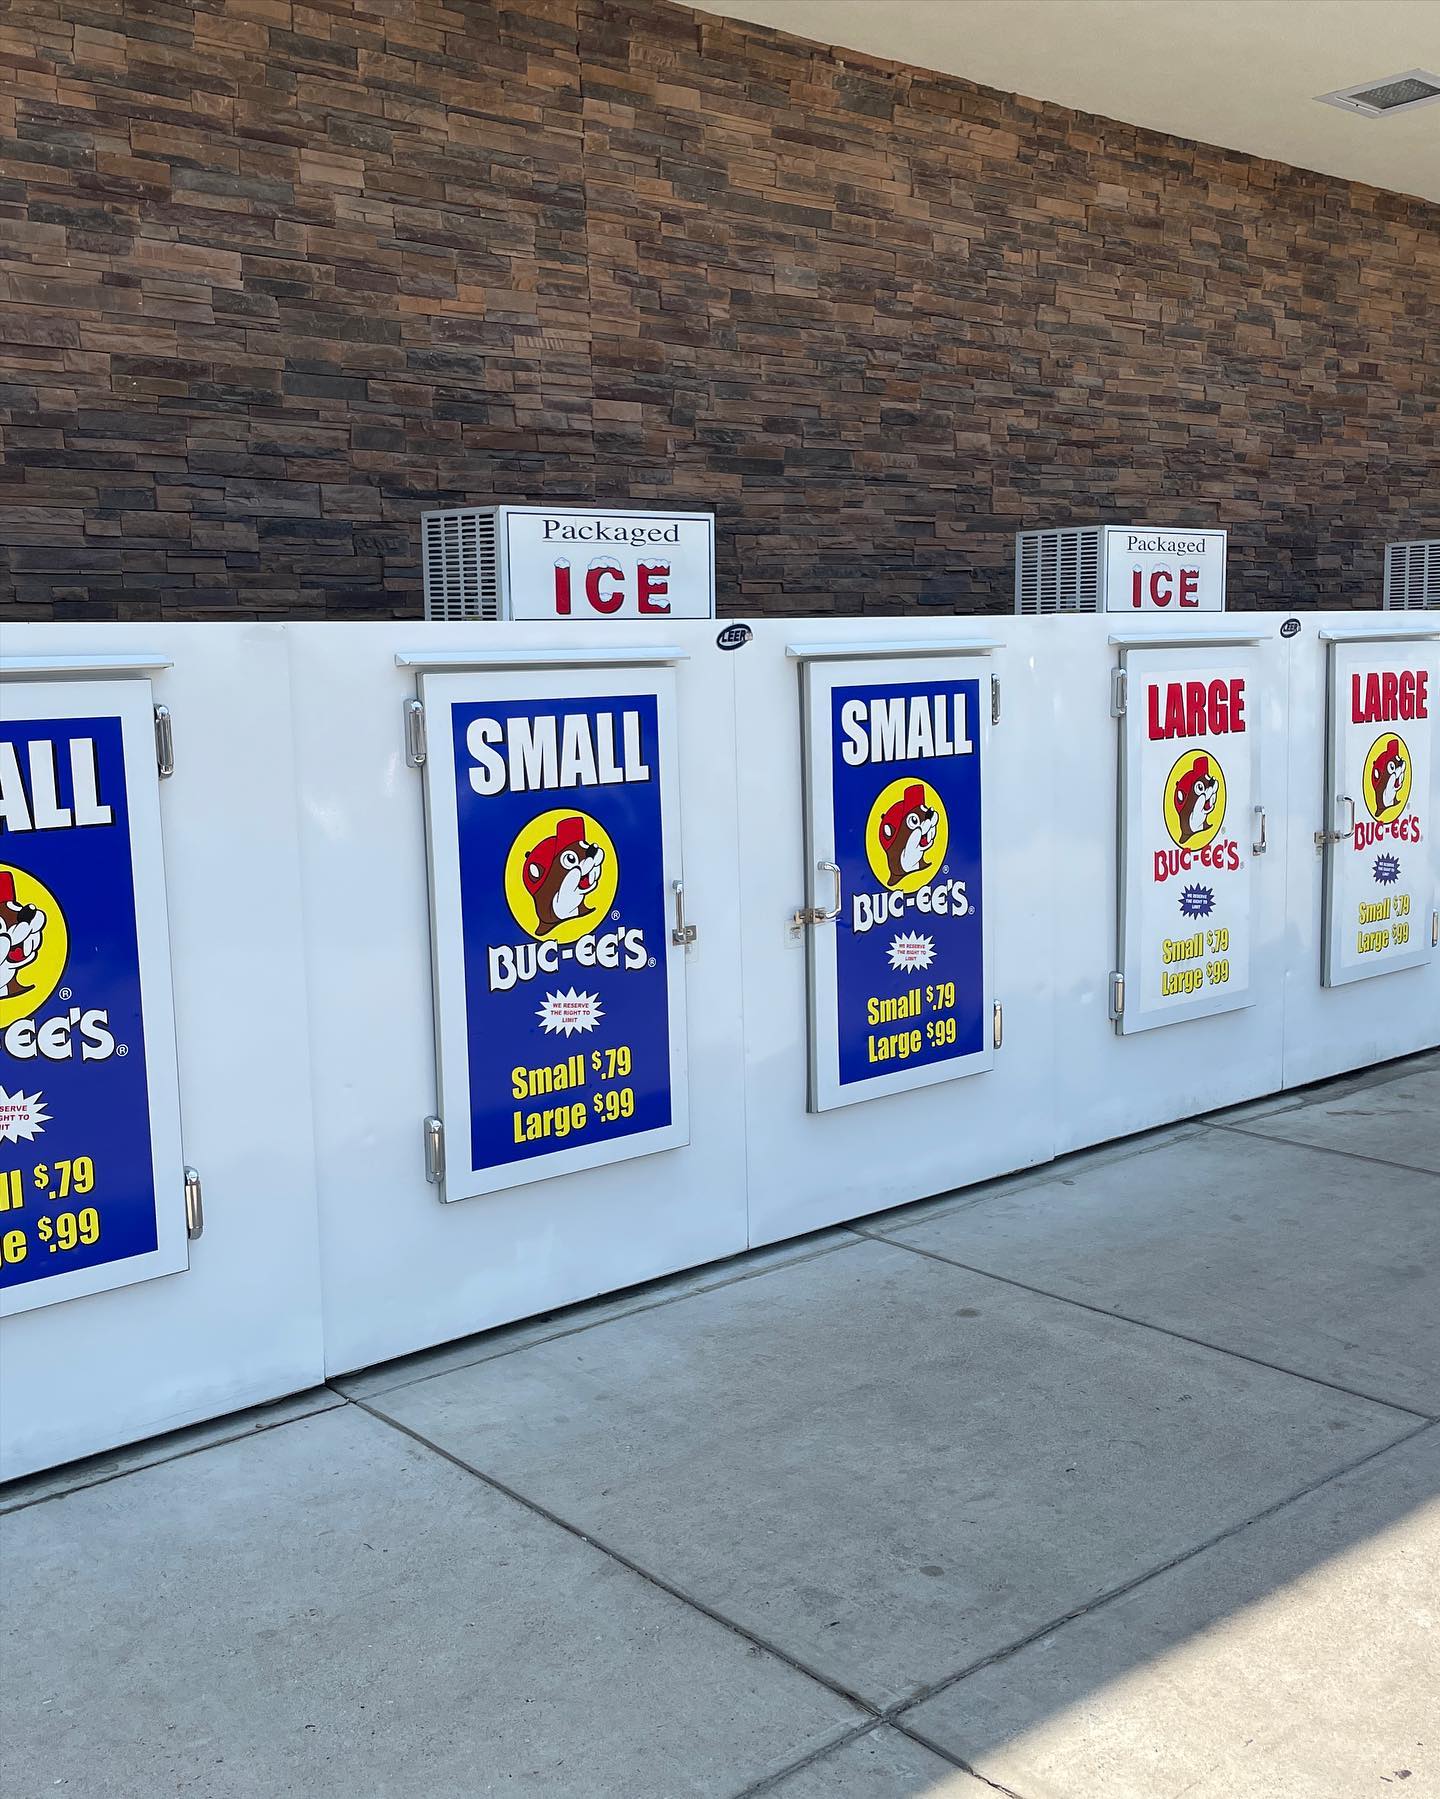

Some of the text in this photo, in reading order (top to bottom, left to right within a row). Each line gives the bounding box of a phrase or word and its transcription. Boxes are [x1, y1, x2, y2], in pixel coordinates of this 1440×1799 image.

[542, 519, 681, 547] Packaged
[1126, 535, 1206, 556] Packaged
[553, 556, 672, 615] ICE
[1131, 562, 1200, 608] ICE
[720, 629, 747, 643] LEER
[1147, 678, 1246, 742] LARGE
[1351, 670, 1429, 725] LARGE
[841, 692, 973, 767] SMALL
[466, 710, 650, 797] SMALL
[1359, 897, 1391, 925] Small
[1162, 927, 1229, 965] Small $.79
[1357, 929, 1390, 954] Large
[1161, 959, 1230, 997] Large $.99
[866, 981, 956, 1026] Small $.79
[868, 1017, 957, 1064] Large $.99
[511, 1045, 633, 1101] Small $.79
[18, 1113, 30, 1121] TO
[512, 1087, 636, 1144] Large $.99
[33, 1155, 95, 1200] $.79
[37, 1206, 101, 1254] $.99
